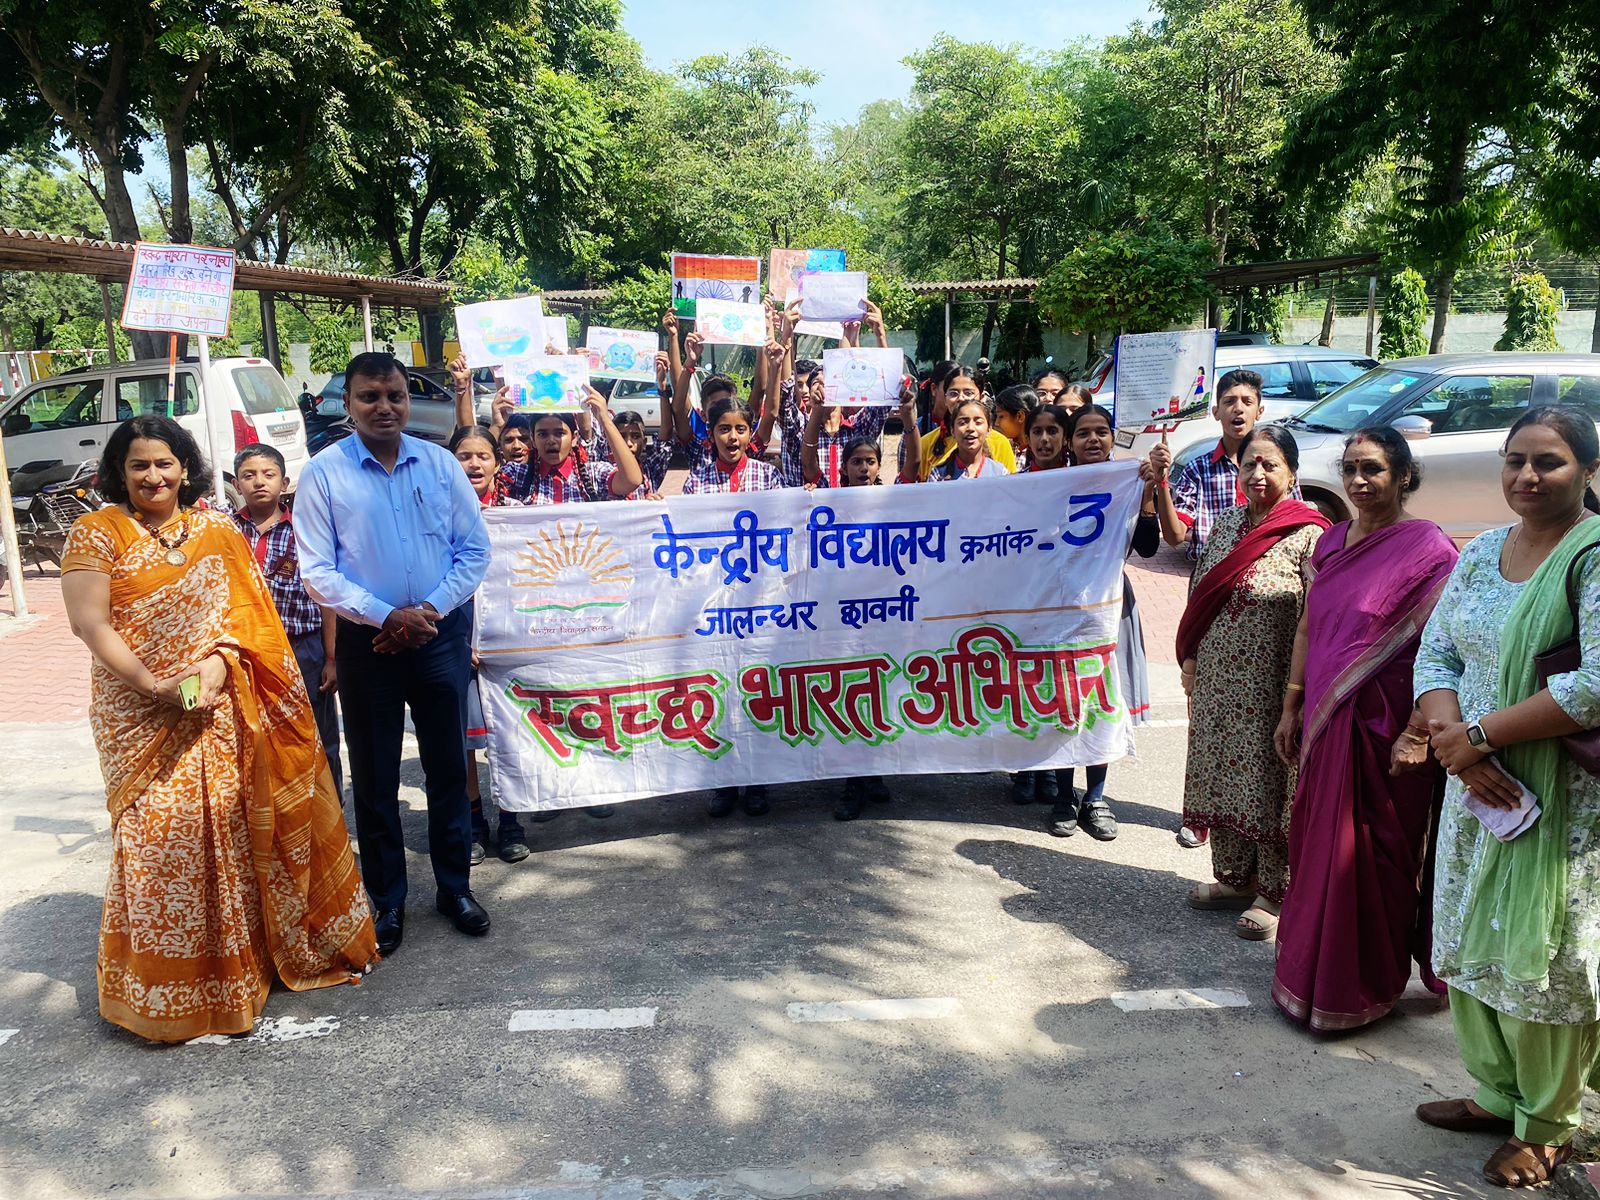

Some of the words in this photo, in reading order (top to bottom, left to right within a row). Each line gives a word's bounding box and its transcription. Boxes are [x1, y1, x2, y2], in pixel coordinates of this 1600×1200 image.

[652, 510, 793, 584] केन्द्रीय
[807, 506, 950, 576] विद्यालय
[695, 600, 818, 639] जालन्धर
[838, 584, 920, 630] छावनी
[508, 671, 724, 762] स्वच्छ
[739, 656, 893, 742] भारत
[901, 624, 1119, 733] अभियान
